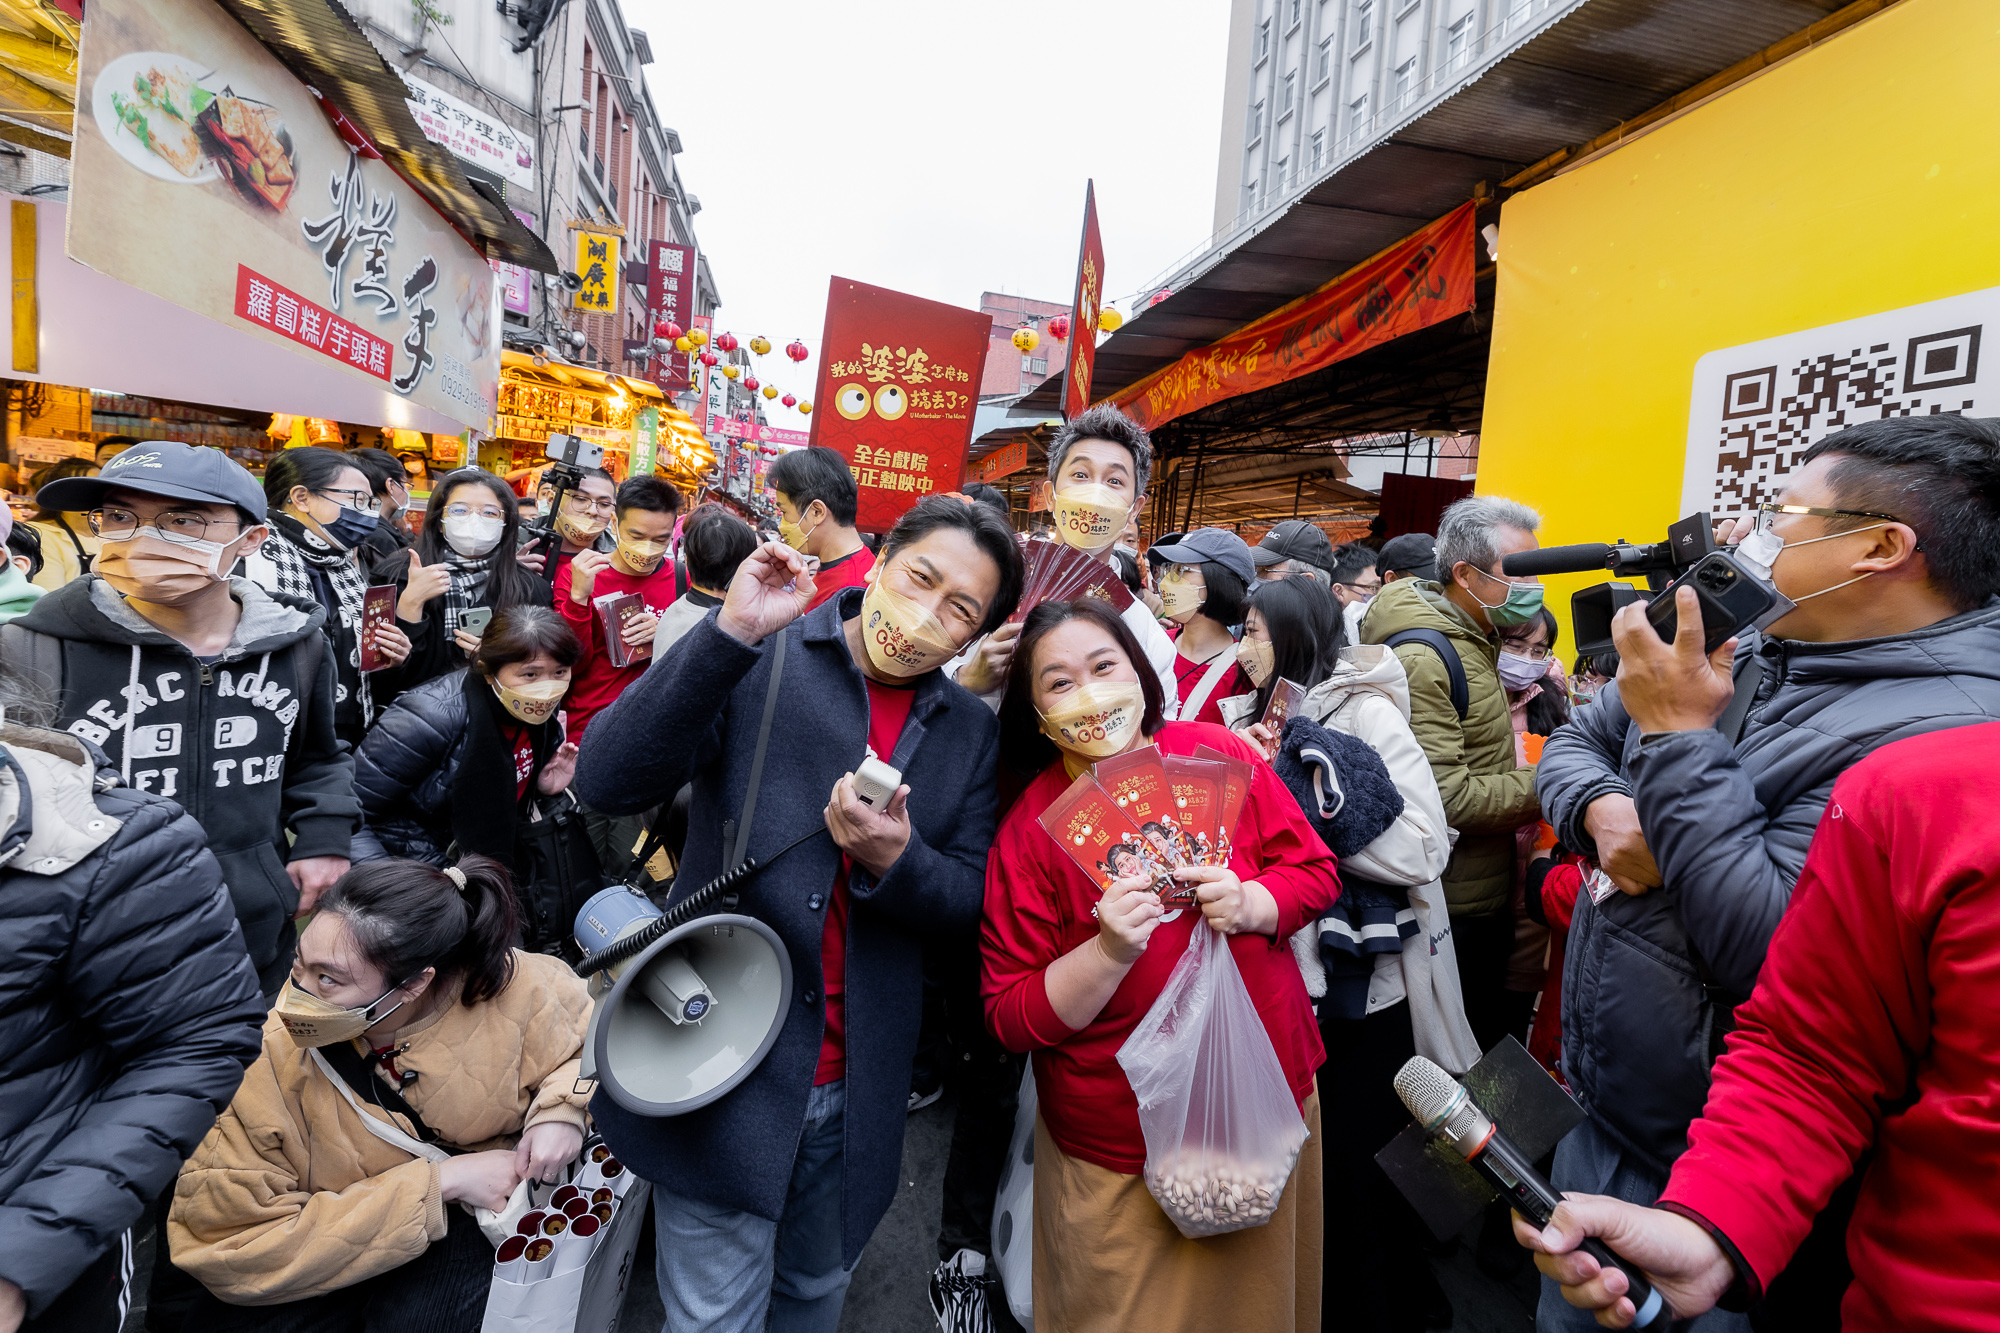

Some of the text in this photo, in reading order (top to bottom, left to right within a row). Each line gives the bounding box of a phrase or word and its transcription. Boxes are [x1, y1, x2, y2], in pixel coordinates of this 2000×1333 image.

[247, 278, 386, 375] 蘿蔔糕/芋頭糕
[830, 342, 969, 384] 我的婆婆怎麼把
[910, 388, 969, 410] 搞丟了?
[853, 444, 929, 473] 全台戲院
[1682, 533, 1693, 542] 4K
